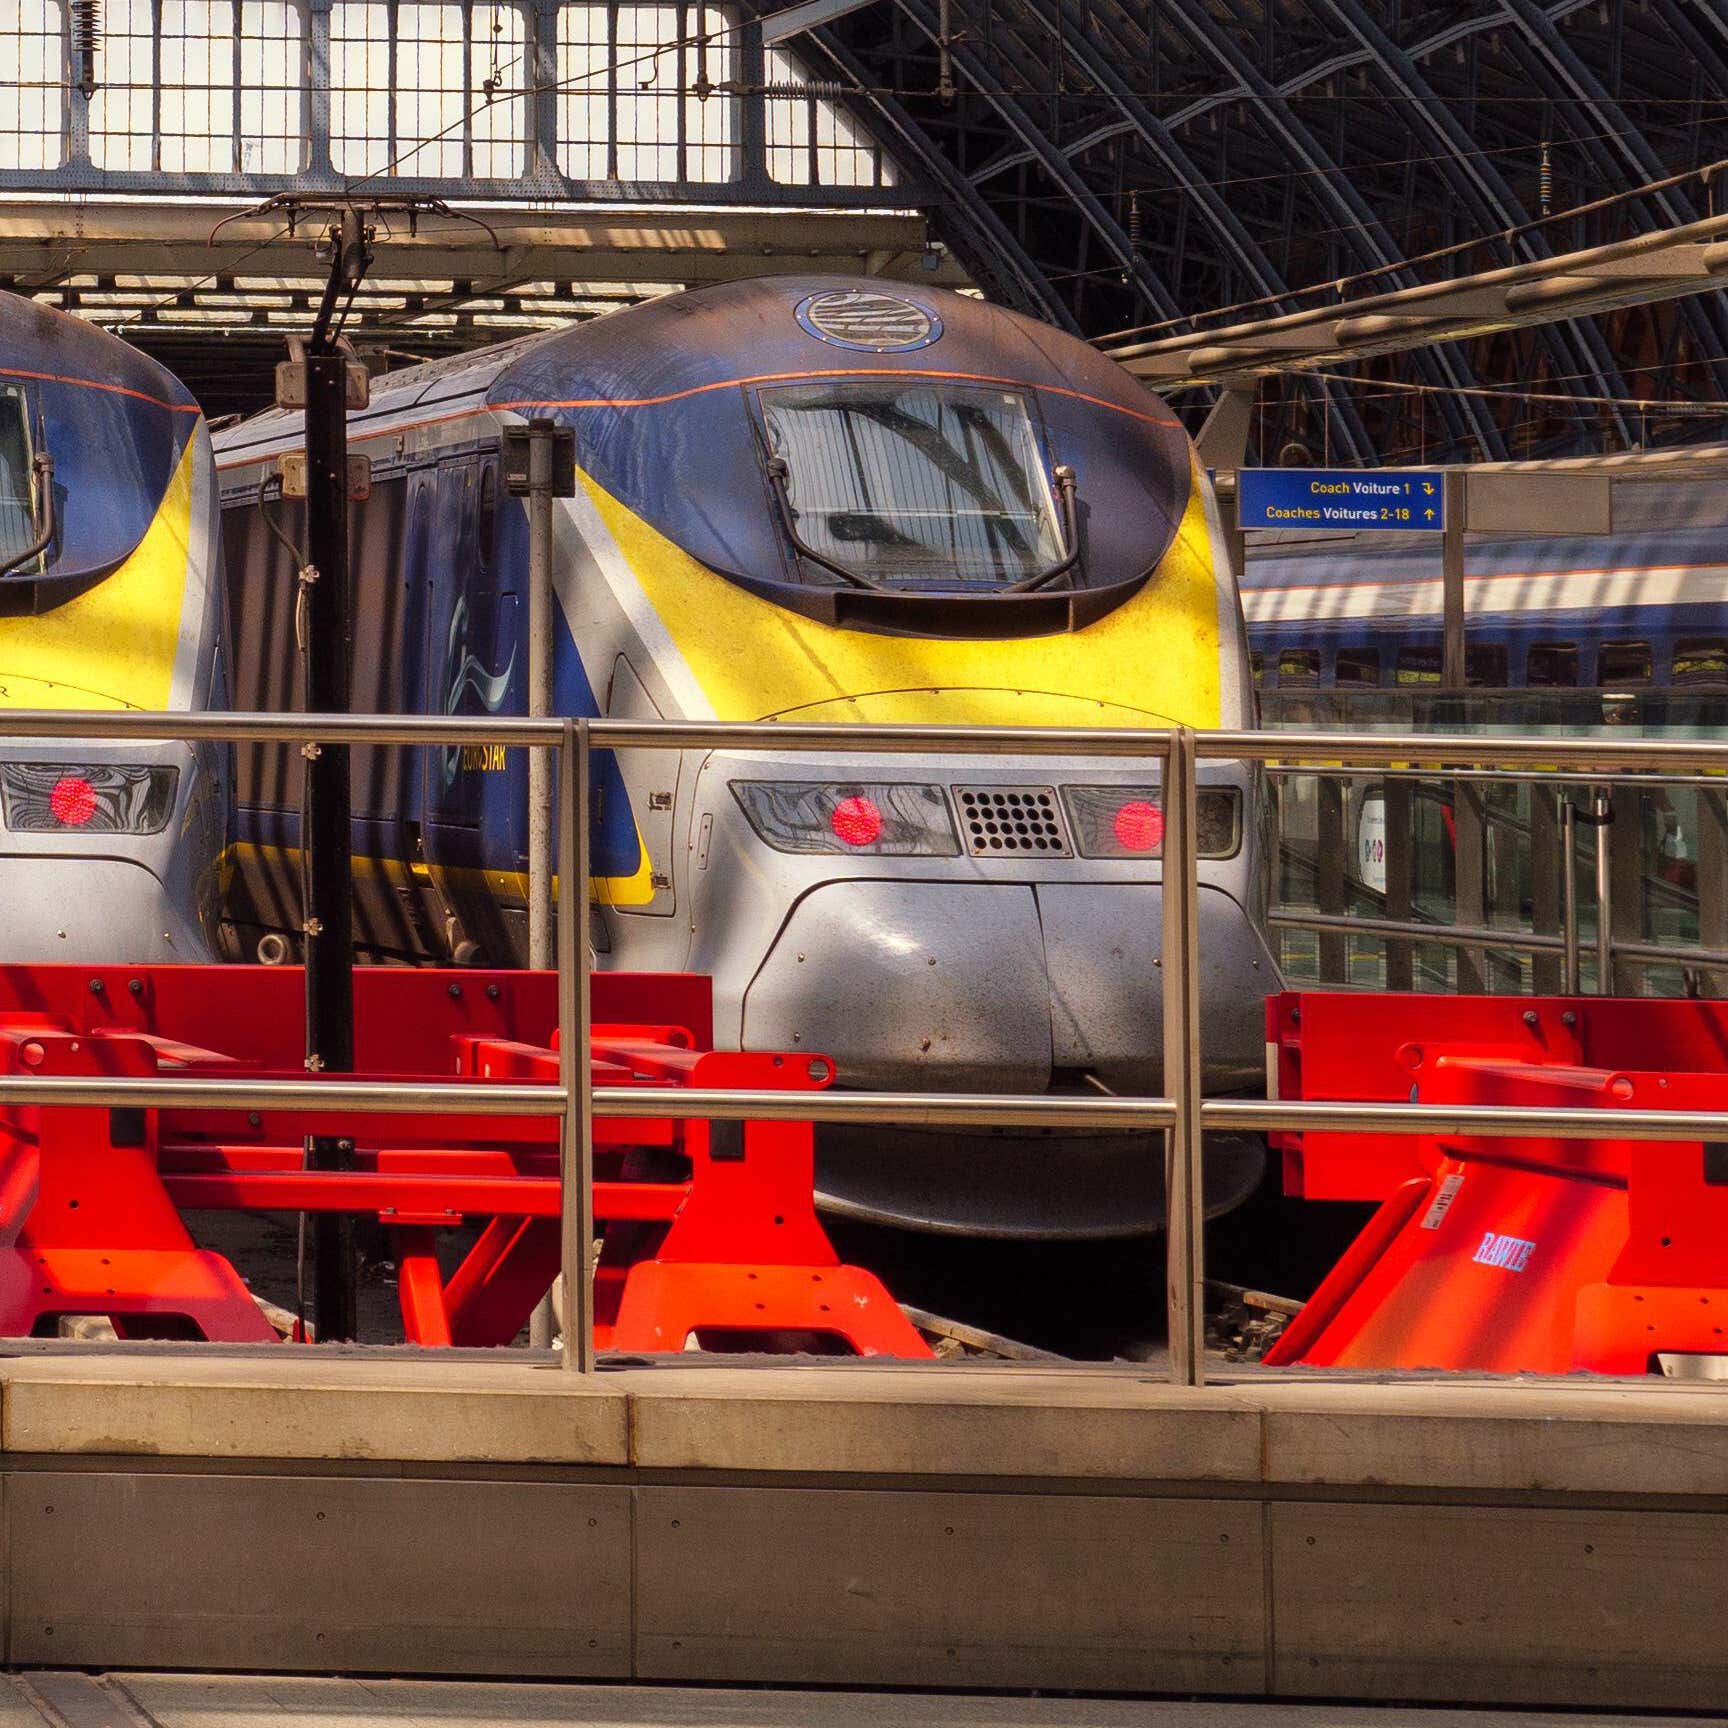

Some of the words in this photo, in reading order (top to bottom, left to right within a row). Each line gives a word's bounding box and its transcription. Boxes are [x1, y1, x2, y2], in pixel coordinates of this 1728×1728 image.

[1310, 481, 1350, 494] Coach
[1352, 482, 1400, 495] Voiture
[1403, 482, 1411, 495] 1
[1265, 505, 1320, 519] Coaches
[1322, 506, 1378, 520] Voitures
[1380, 507, 1410, 520] 2-18
[1472, 1232, 1536, 1273] RAWIE
